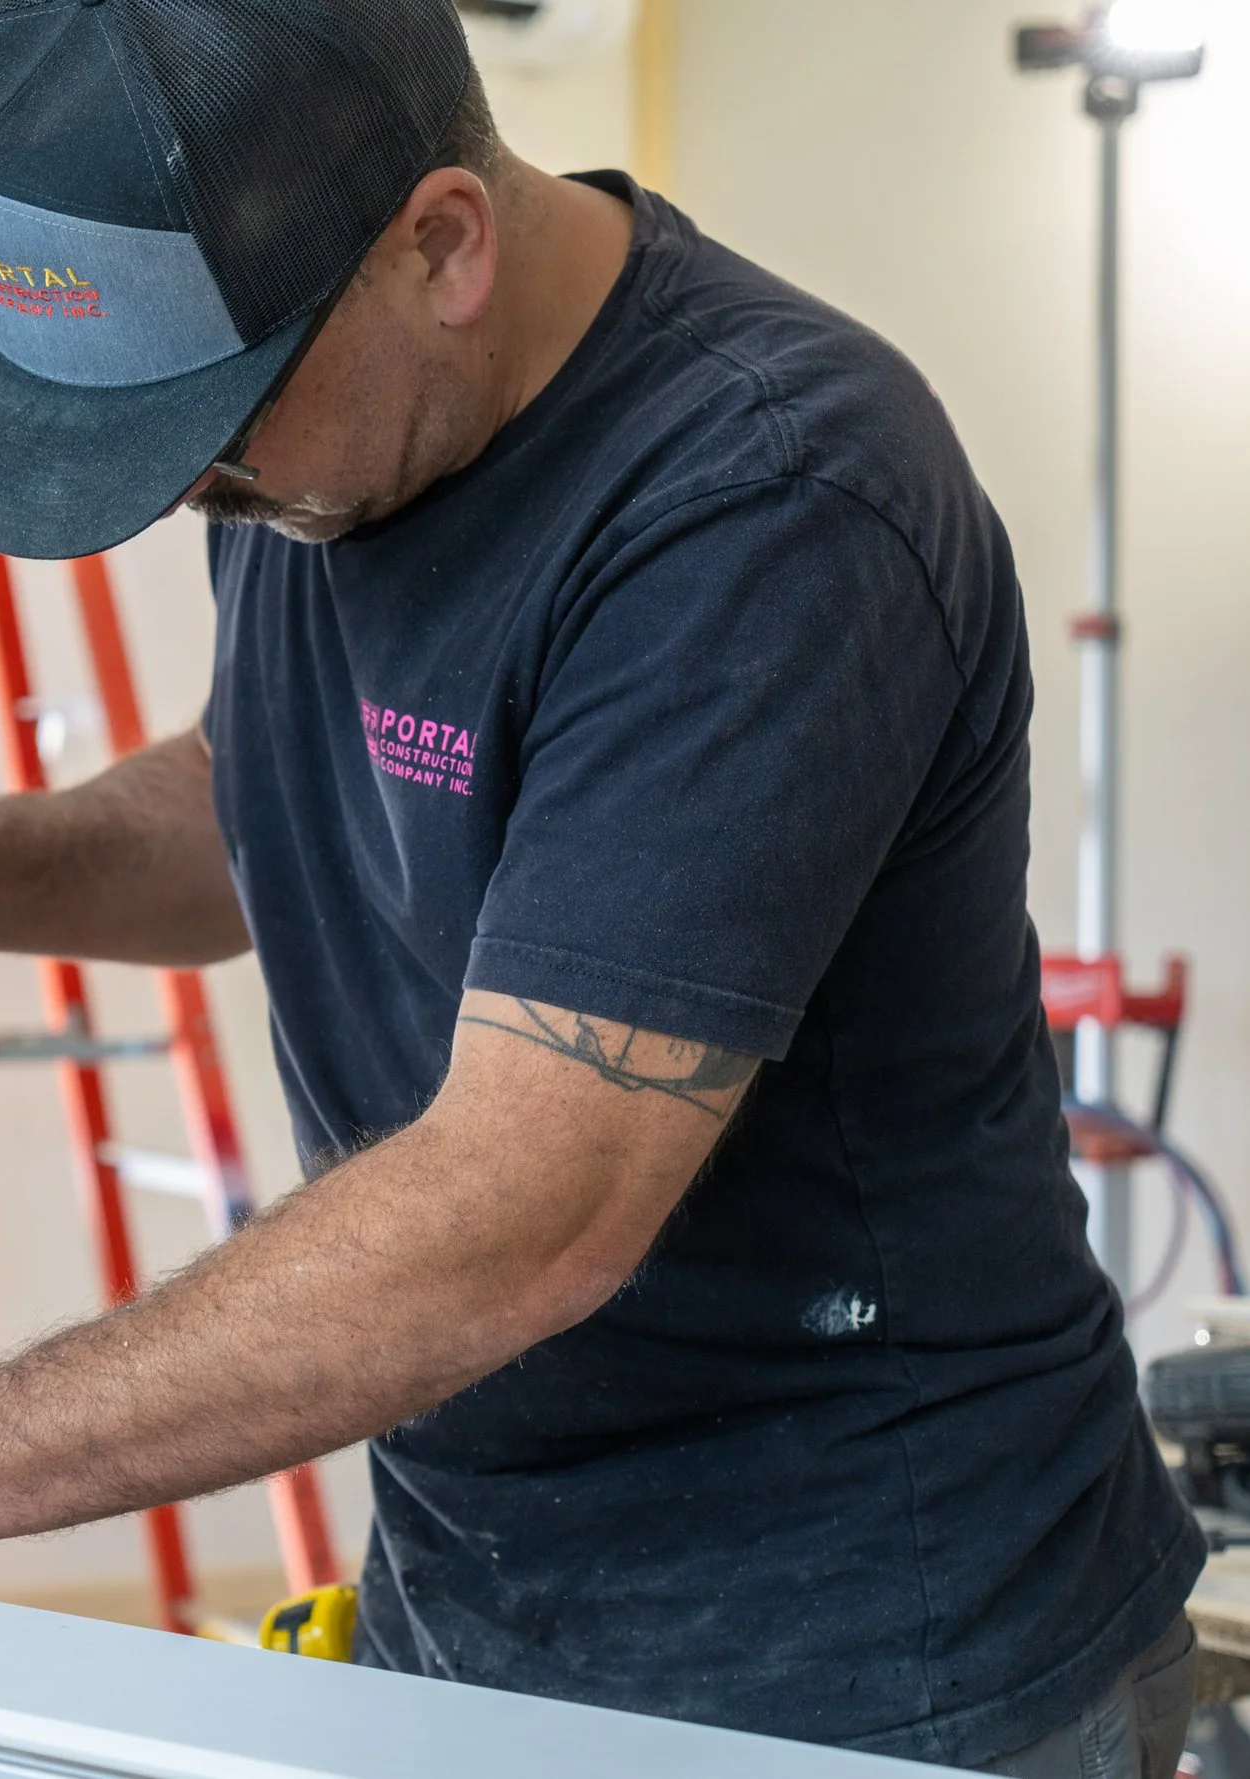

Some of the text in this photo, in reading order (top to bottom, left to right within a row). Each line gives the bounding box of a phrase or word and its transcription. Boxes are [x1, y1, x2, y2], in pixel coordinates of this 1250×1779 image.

[63, 304, 108, 319] INC.
[380, 738, 473, 777] CONSTRUCTION
[380, 756, 473, 796] COMPANY INC.
